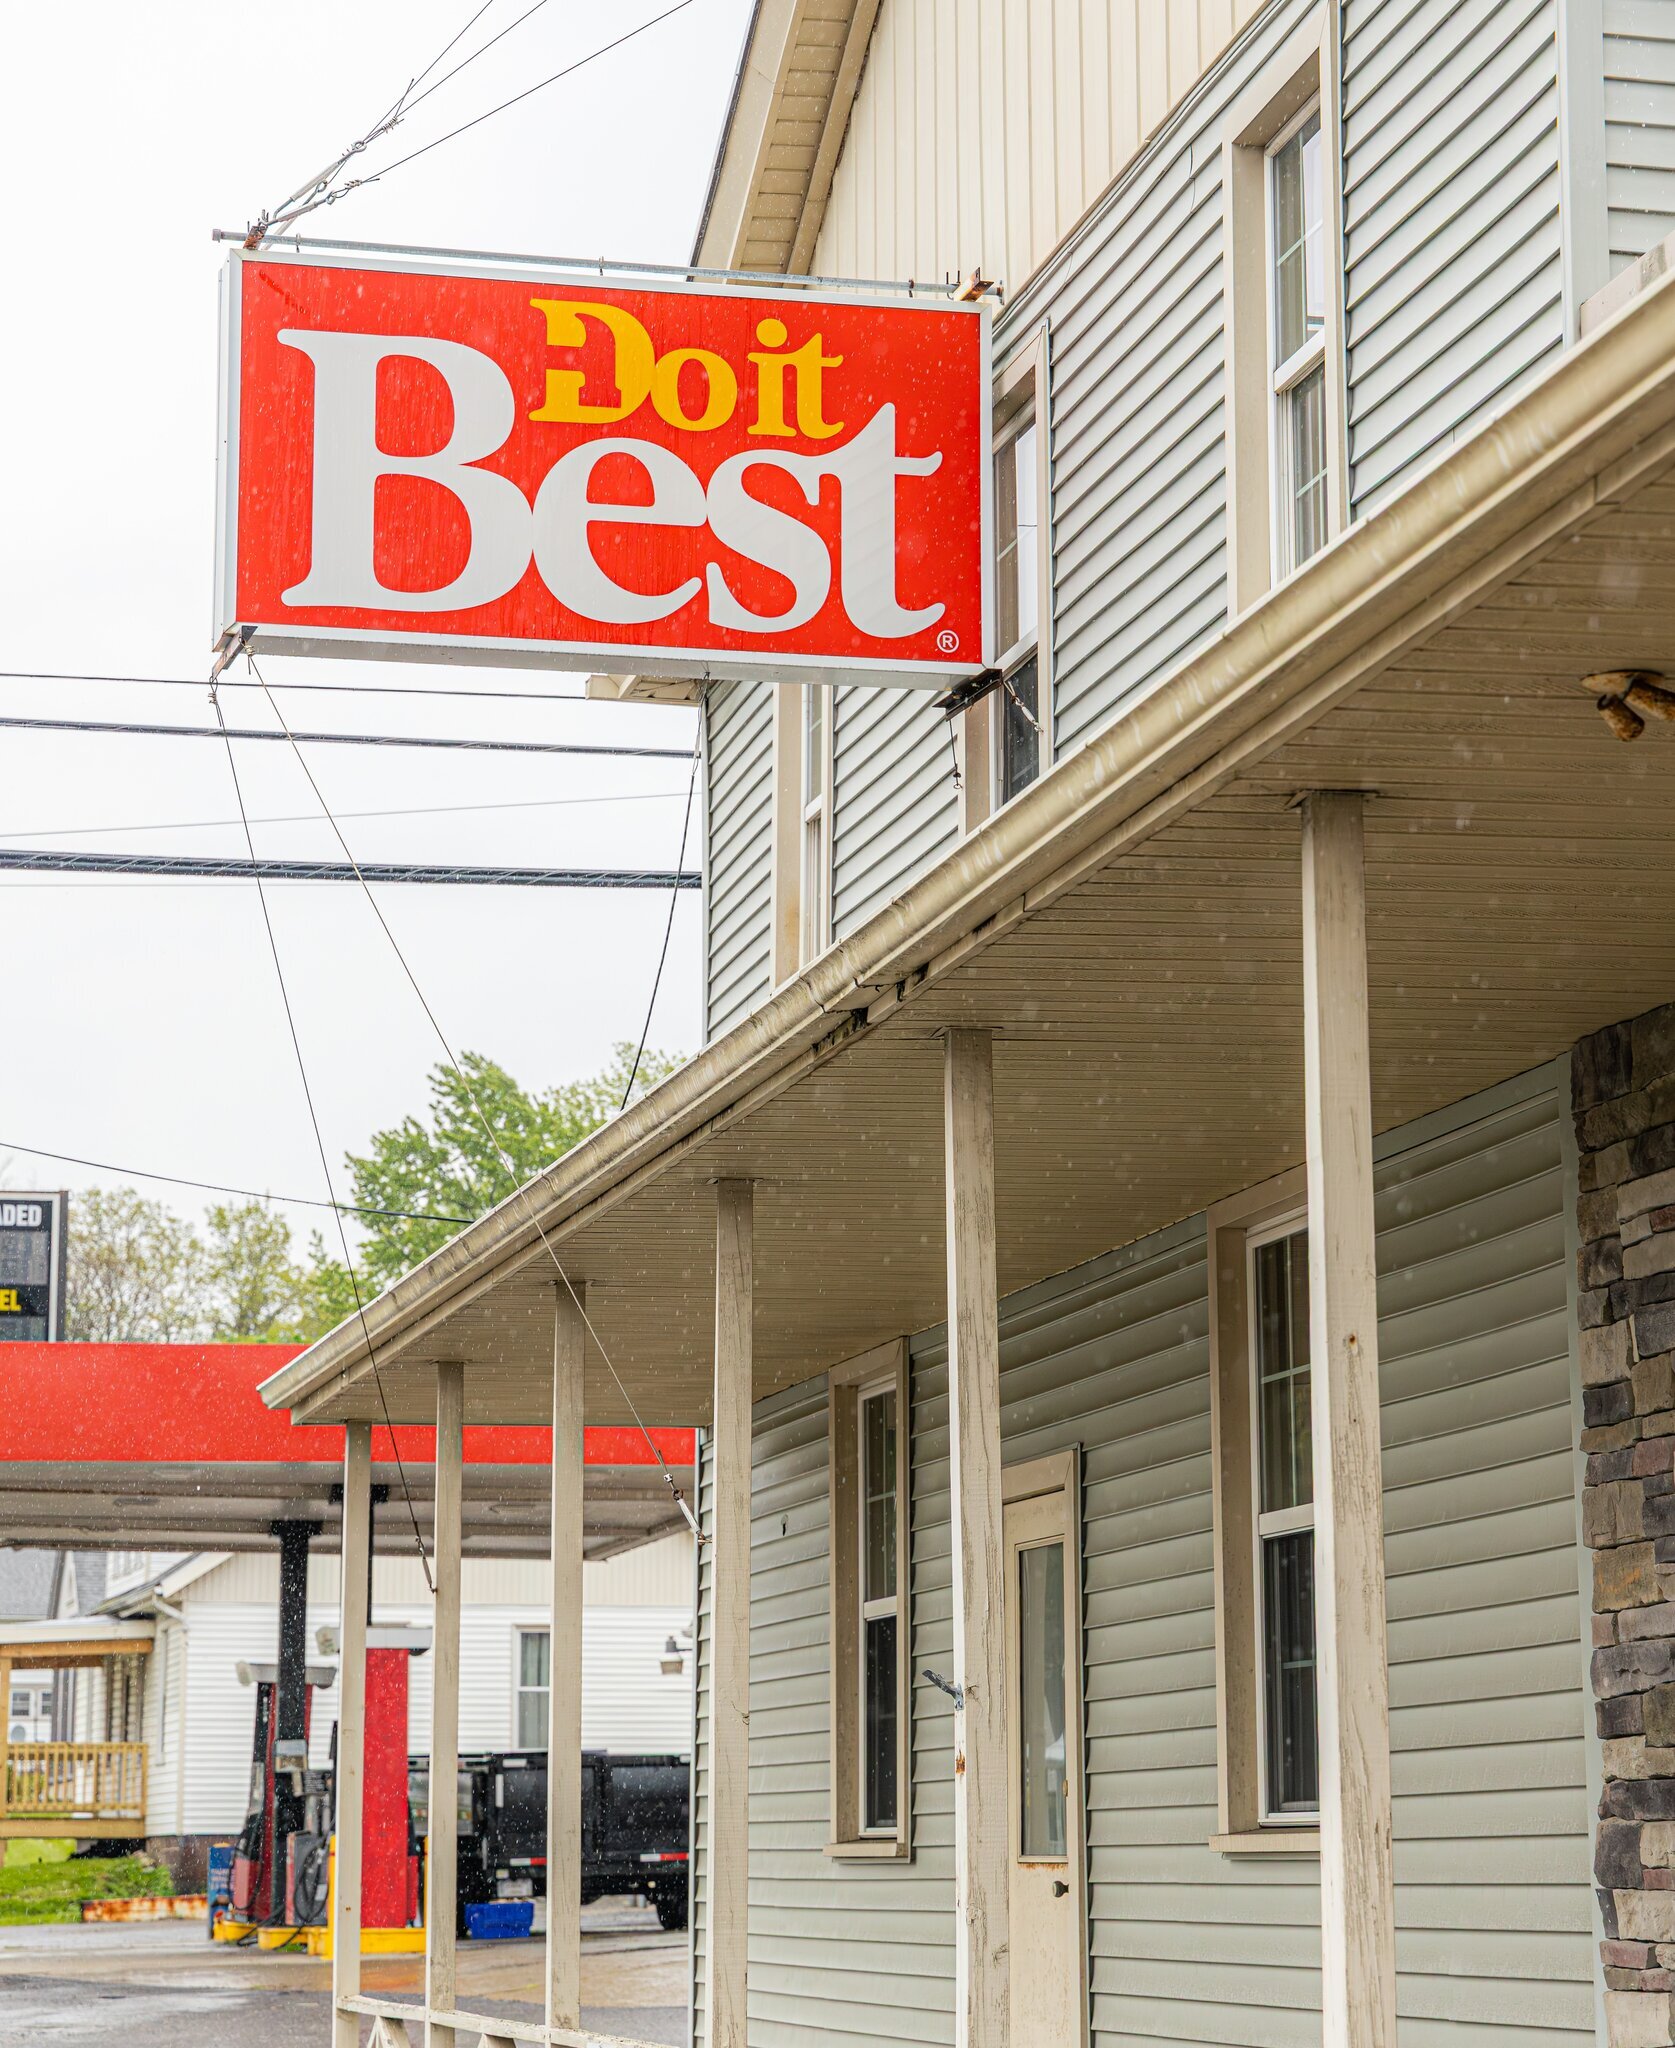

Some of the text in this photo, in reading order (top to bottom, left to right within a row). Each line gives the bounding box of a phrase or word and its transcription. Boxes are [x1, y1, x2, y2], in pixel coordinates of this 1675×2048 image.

[529, 298, 845, 439] Do it
[277, 328, 945, 640] Best
[0, 1203, 42, 1227] DED
